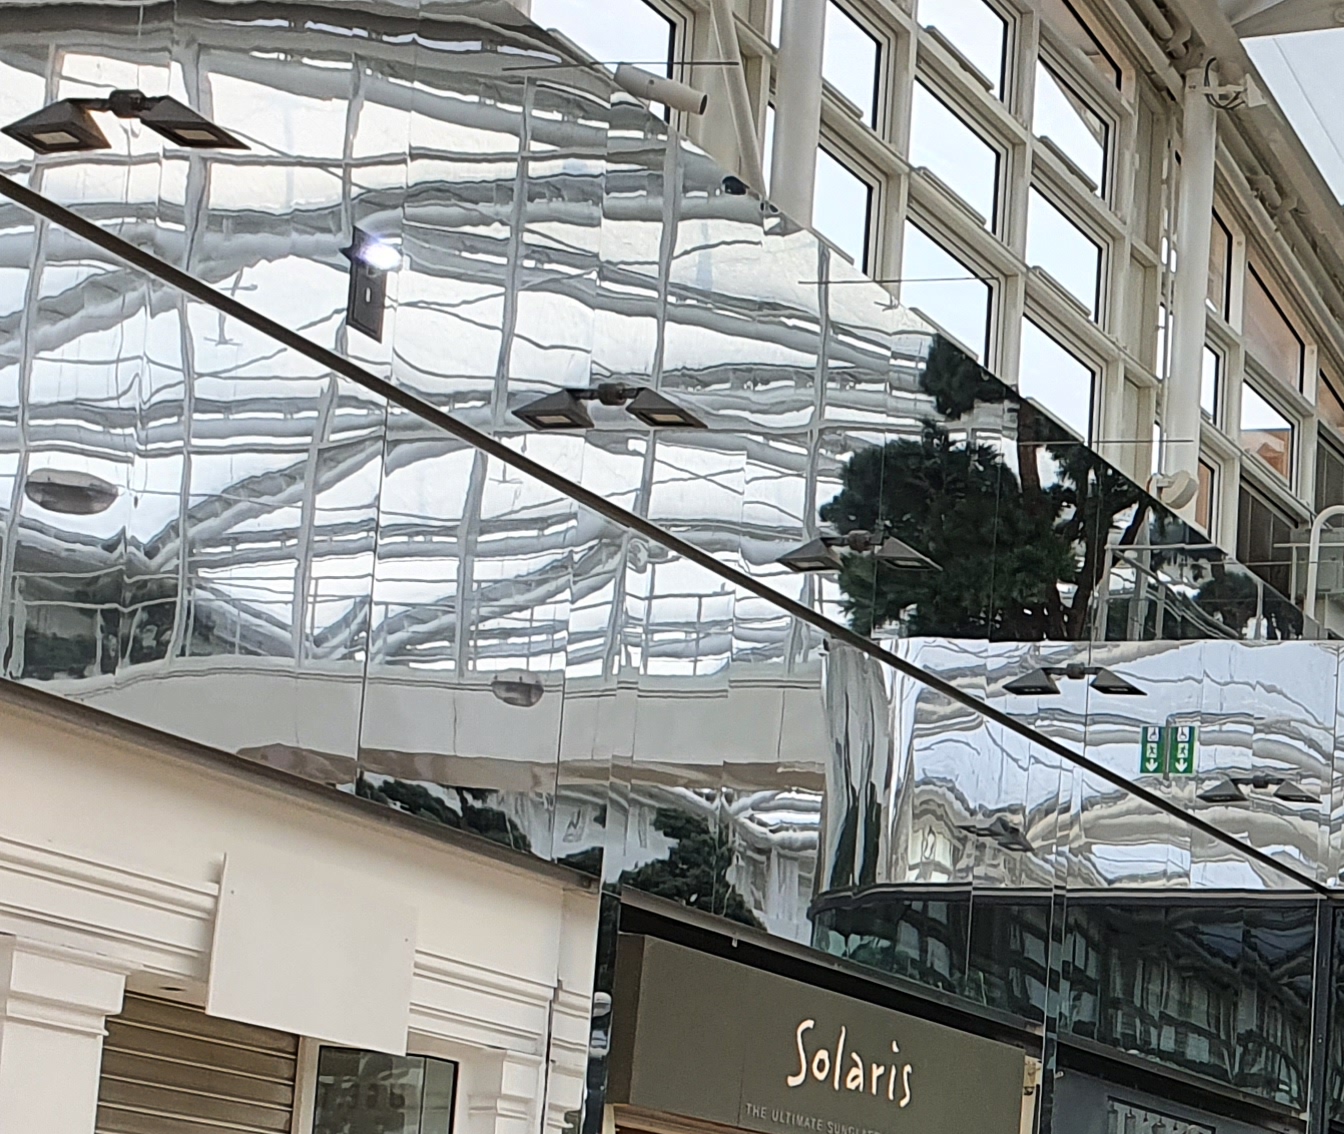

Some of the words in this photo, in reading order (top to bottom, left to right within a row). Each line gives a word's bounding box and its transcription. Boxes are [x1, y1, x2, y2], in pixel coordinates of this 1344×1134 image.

[787, 1018, 913, 1108] Solaris
[745, 1102, 768, 1121] THE
[771, 1109, 824, 1133] ULTIMATE
